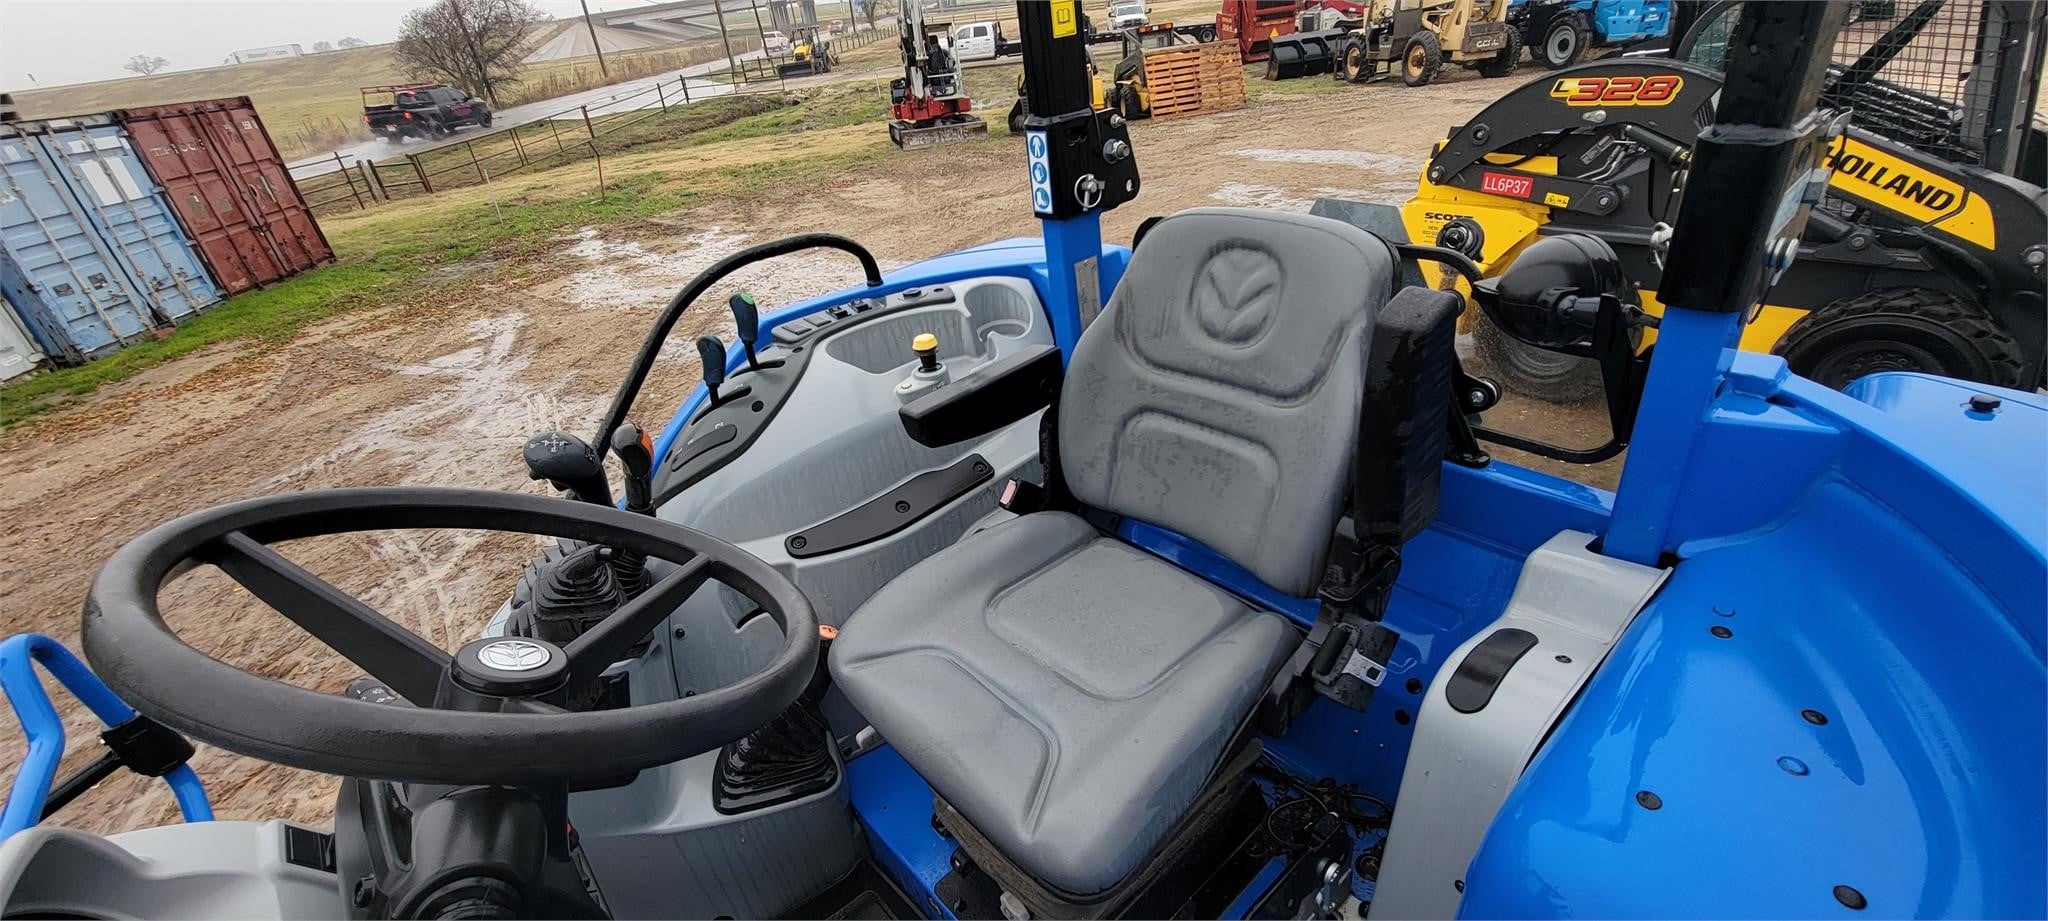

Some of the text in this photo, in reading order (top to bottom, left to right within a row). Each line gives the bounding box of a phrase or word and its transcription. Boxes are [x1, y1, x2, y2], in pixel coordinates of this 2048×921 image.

[1483, 176, 1530, 195] LL6P37
[1825, 146, 1956, 211] HOLLAND
[1424, 212, 1474, 221] SCO
